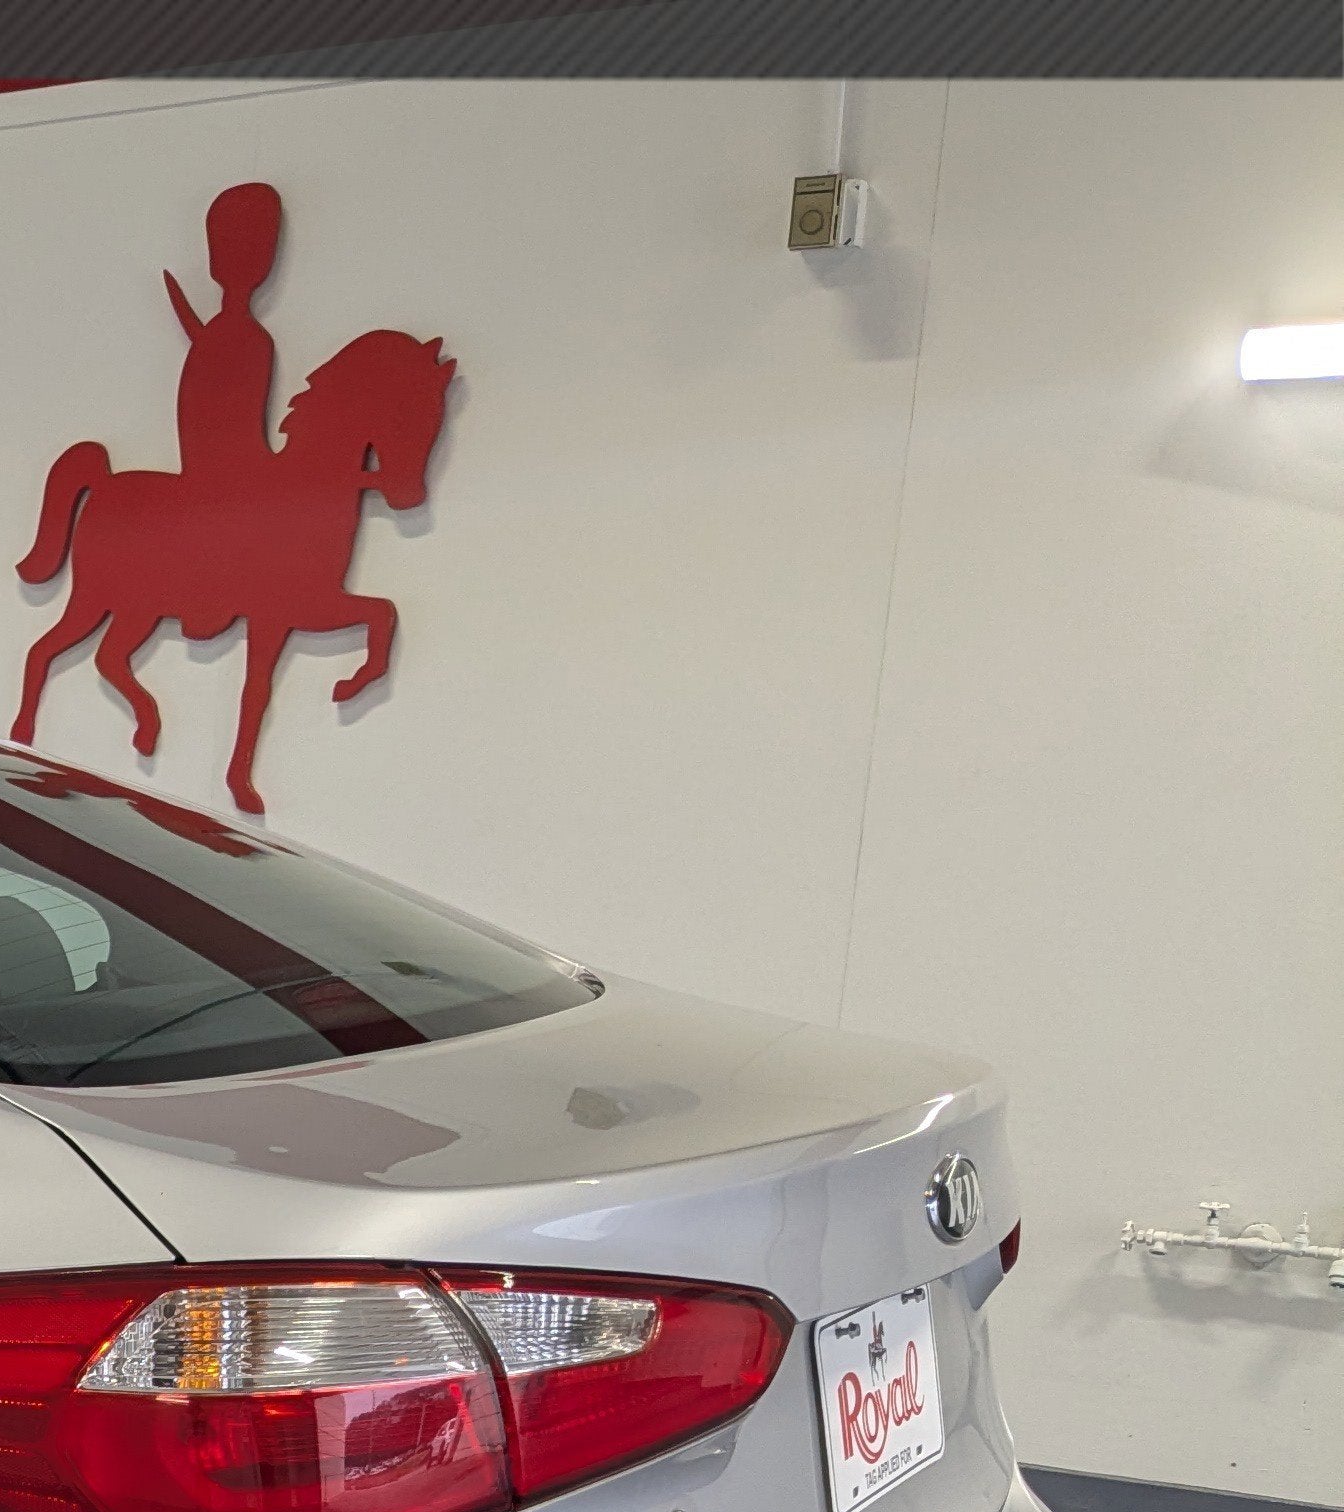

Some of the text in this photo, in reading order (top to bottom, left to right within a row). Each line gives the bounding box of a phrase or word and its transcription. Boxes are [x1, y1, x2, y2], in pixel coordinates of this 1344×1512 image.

[837, 1340, 925, 1465] Royal
[864, 1446, 912, 1489] TAG APPLIED FOR
